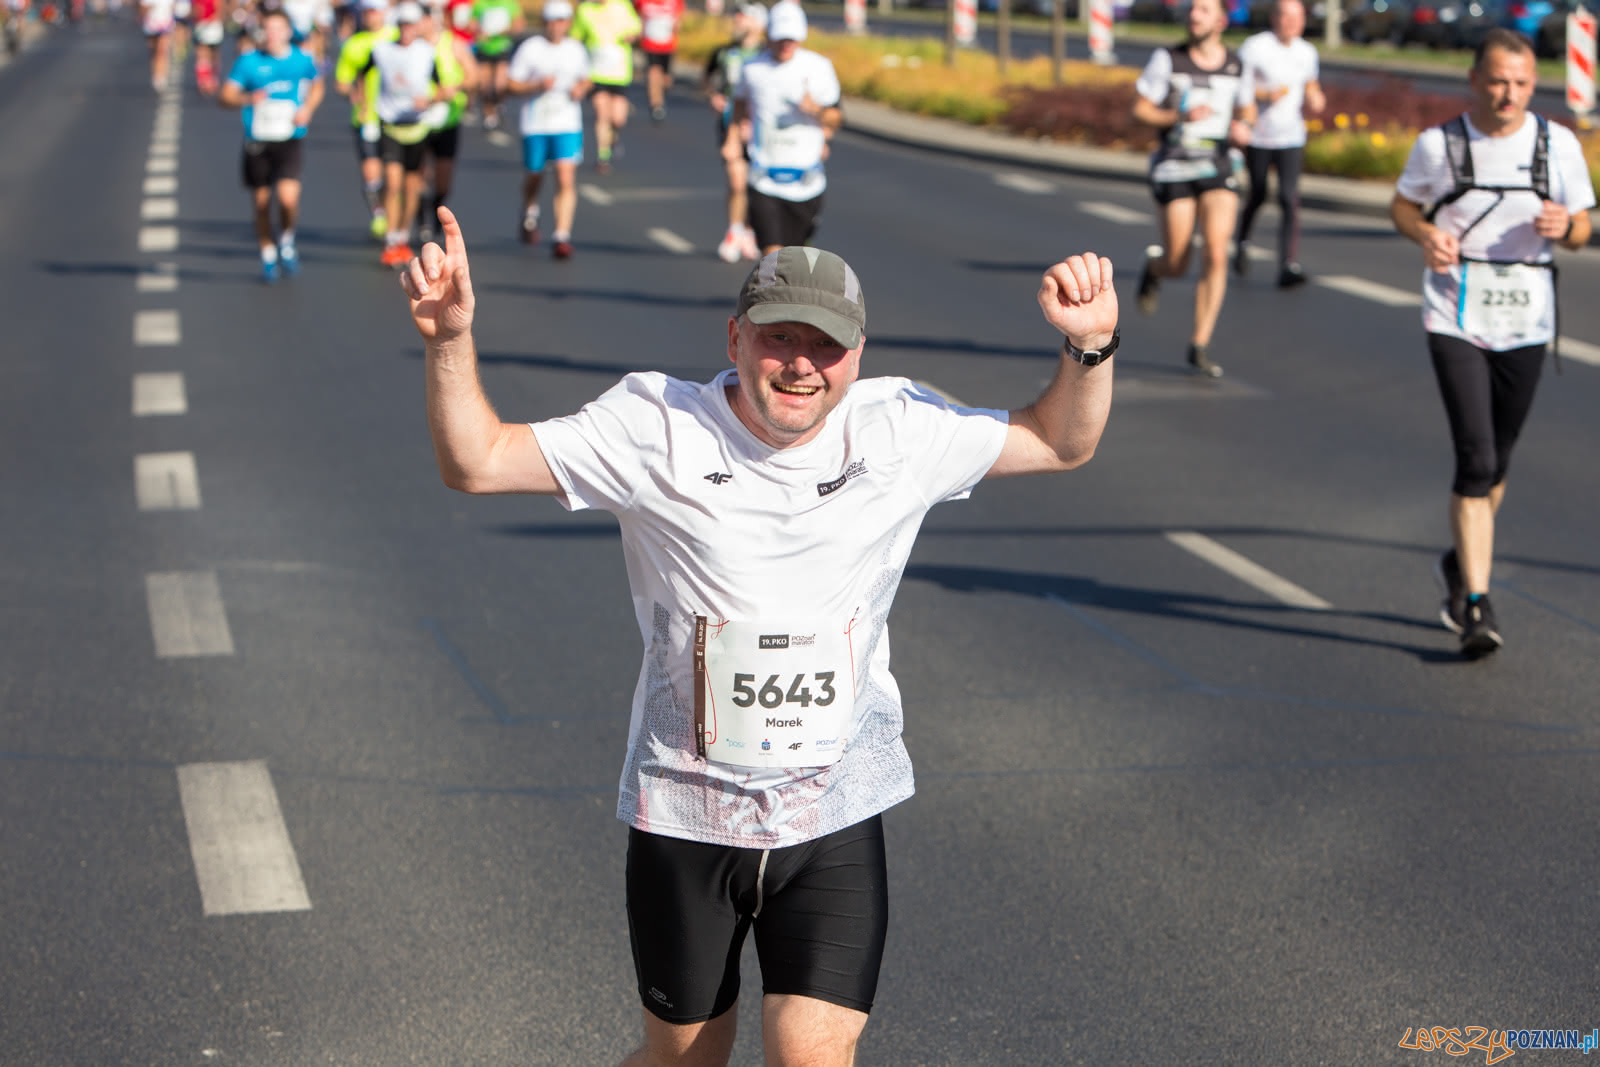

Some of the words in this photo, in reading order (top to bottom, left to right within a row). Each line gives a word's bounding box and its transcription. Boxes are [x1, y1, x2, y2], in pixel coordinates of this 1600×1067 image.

[1482, 289, 1530, 307] 2253
[703, 472, 733, 485] 4F
[762, 638, 771, 646] 19.
[772, 638, 788, 646] PKO
[732, 671, 836, 709] 5643
[766, 717, 803, 728] Marek
[788, 742, 803, 751] 4F
